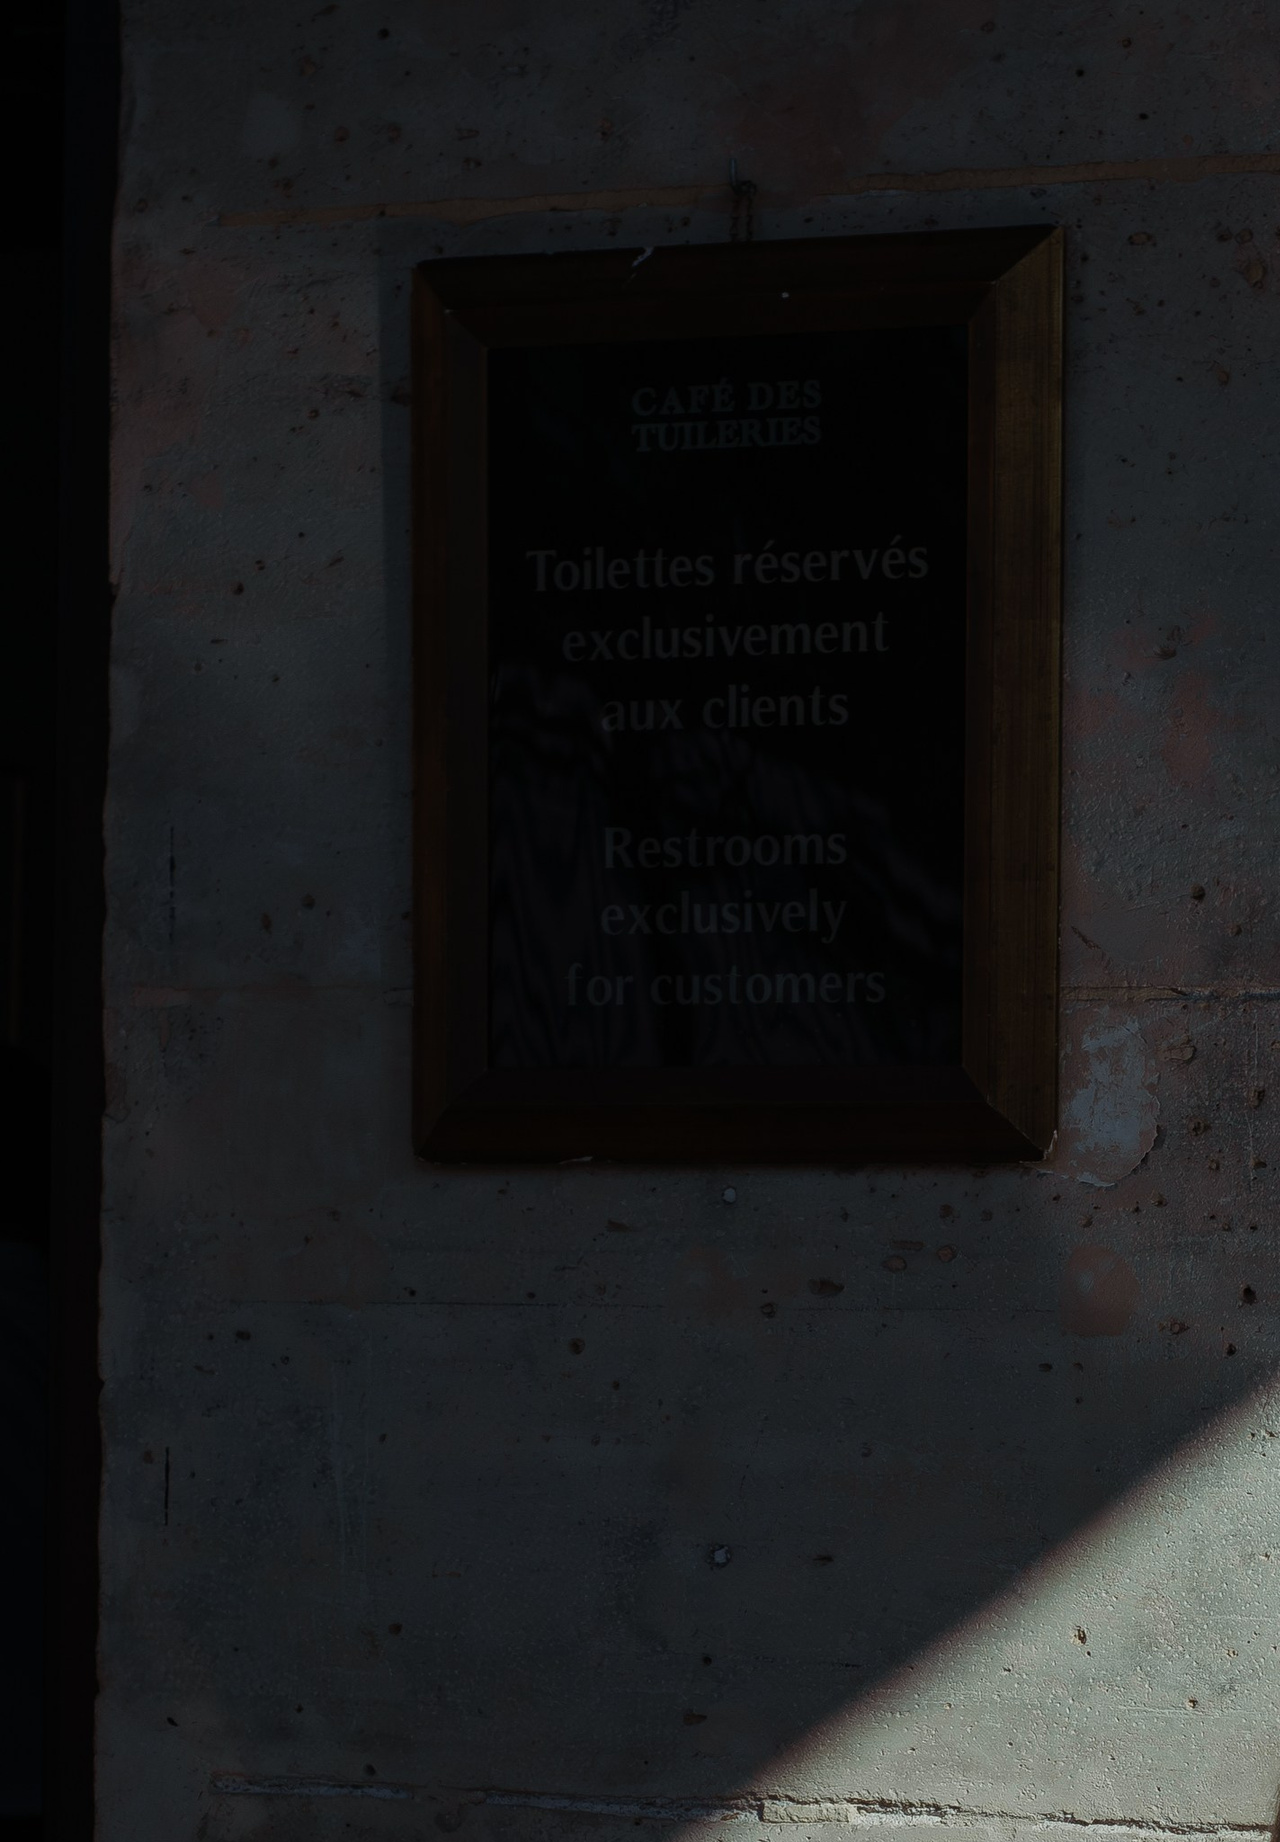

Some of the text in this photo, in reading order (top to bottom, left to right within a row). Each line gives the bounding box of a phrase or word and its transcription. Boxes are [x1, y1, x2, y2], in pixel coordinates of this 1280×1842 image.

[631, 376, 823, 417] CAFÉ DES
[631, 416, 823, 453] TUILERIES
[526, 533, 929, 592] Toilettes réservés
[562, 610, 890, 663] exclusivement
[602, 682, 850, 734] aux clients
[604, 826, 848, 870] Restrooms
[601, 888, 848, 944] exclusively
[564, 963, 886, 1006] for customers
